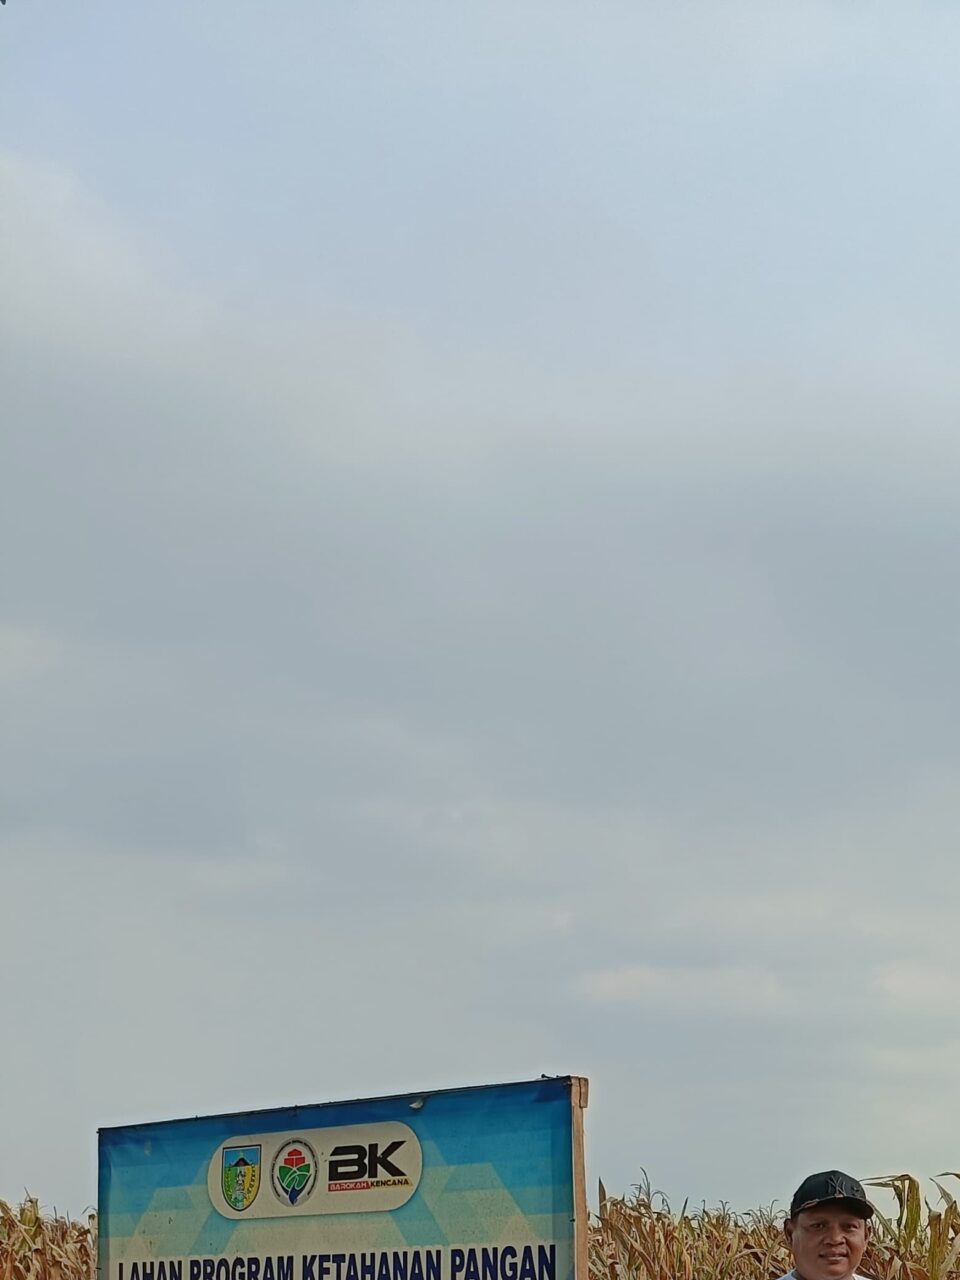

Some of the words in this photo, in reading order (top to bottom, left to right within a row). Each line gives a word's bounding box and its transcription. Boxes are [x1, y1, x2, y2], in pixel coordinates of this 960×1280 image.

[328, 1140, 407, 1182] BK
[329, 1182, 368, 1191] BAROKAH
[370, 1179, 410, 1189] KENCANA
